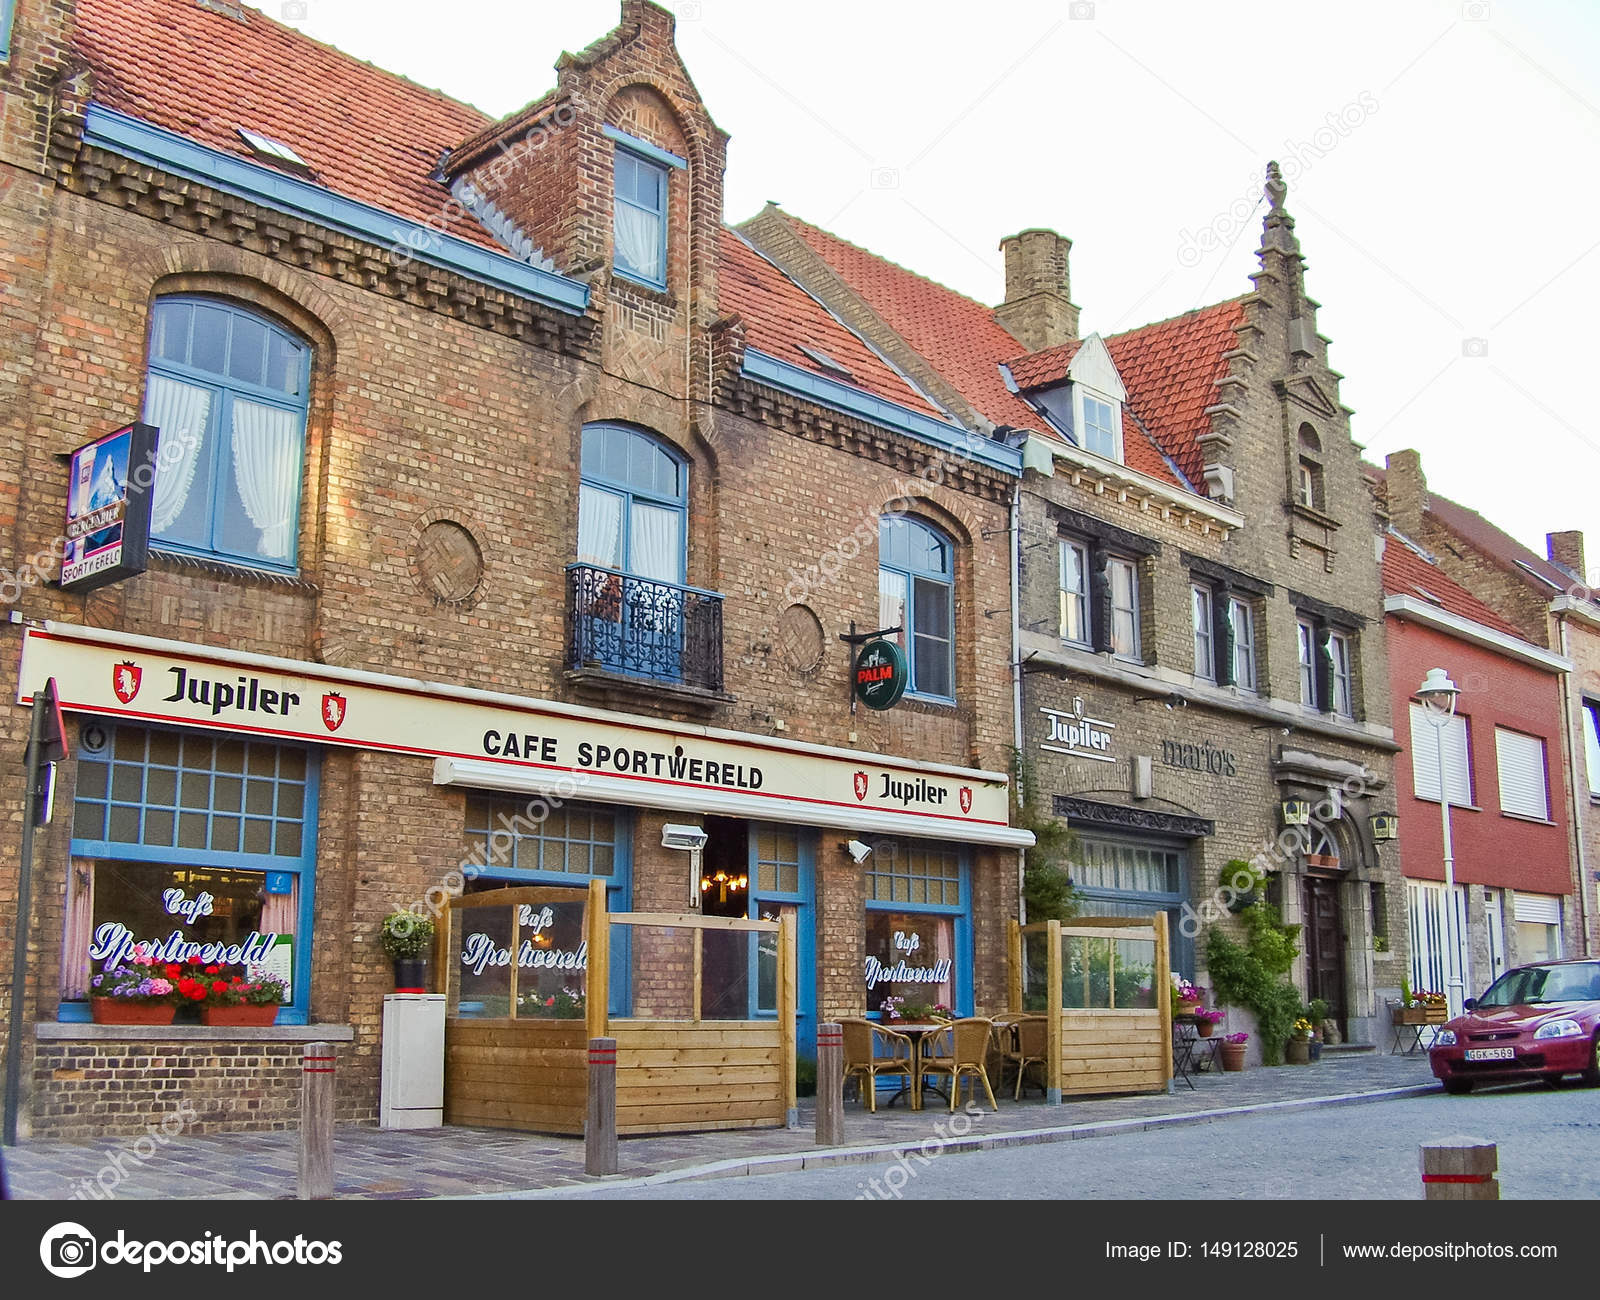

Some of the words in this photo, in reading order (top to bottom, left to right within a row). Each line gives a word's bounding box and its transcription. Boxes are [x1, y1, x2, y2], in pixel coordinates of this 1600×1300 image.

[162, 666, 300, 716] Jupiler
[857, 665, 893, 684] PALM
[1046, 714, 1111, 750] Jupiler
[483, 730, 557, 762] CAFE
[578, 742, 763, 789] SPORTWERELD
[1161, 738, 1236, 777] mario's
[879, 773, 947, 806] Jupiler
[161, 887, 213, 925] Café
[865, 955, 952, 990] Sportwereld
